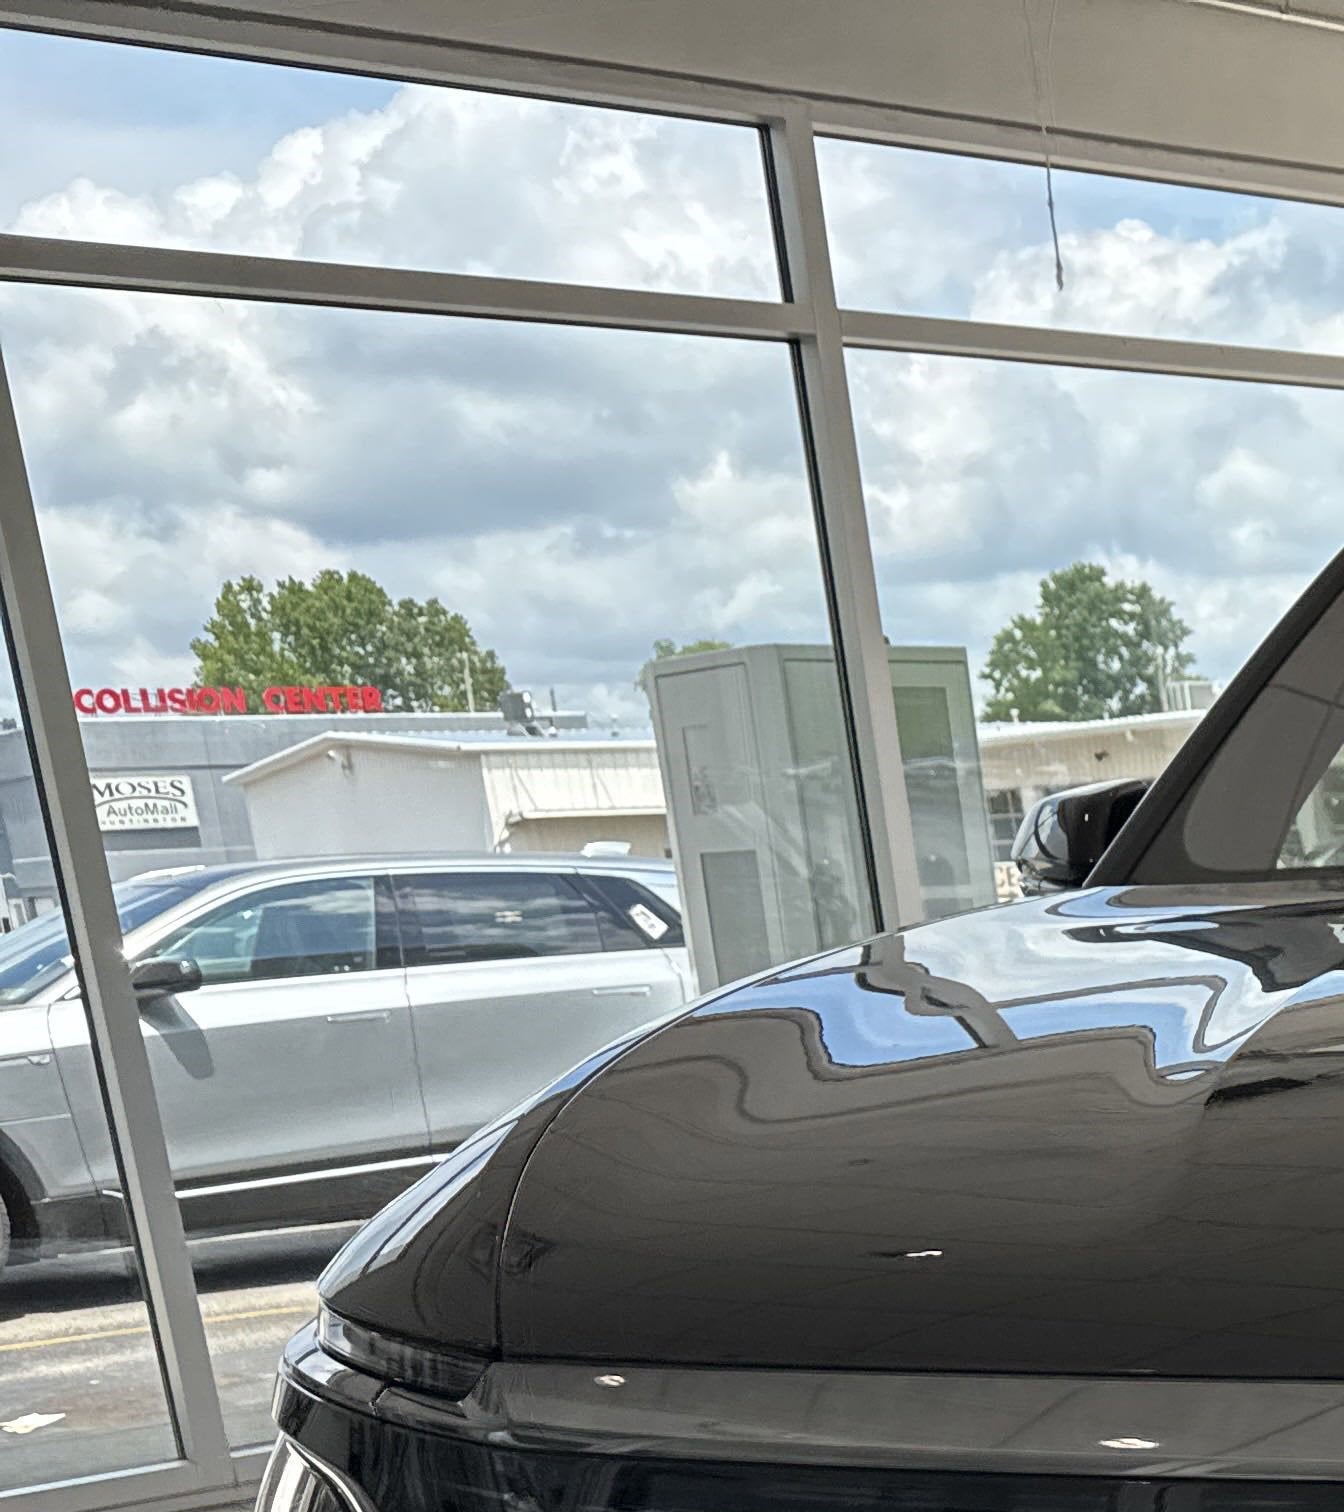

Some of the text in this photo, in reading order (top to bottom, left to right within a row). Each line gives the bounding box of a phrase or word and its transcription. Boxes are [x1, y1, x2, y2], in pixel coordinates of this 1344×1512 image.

[73, 686, 384, 714] COLLISION CENTER
[92, 780, 186, 798] MOSES
[106, 802, 178, 818] AutoMall
